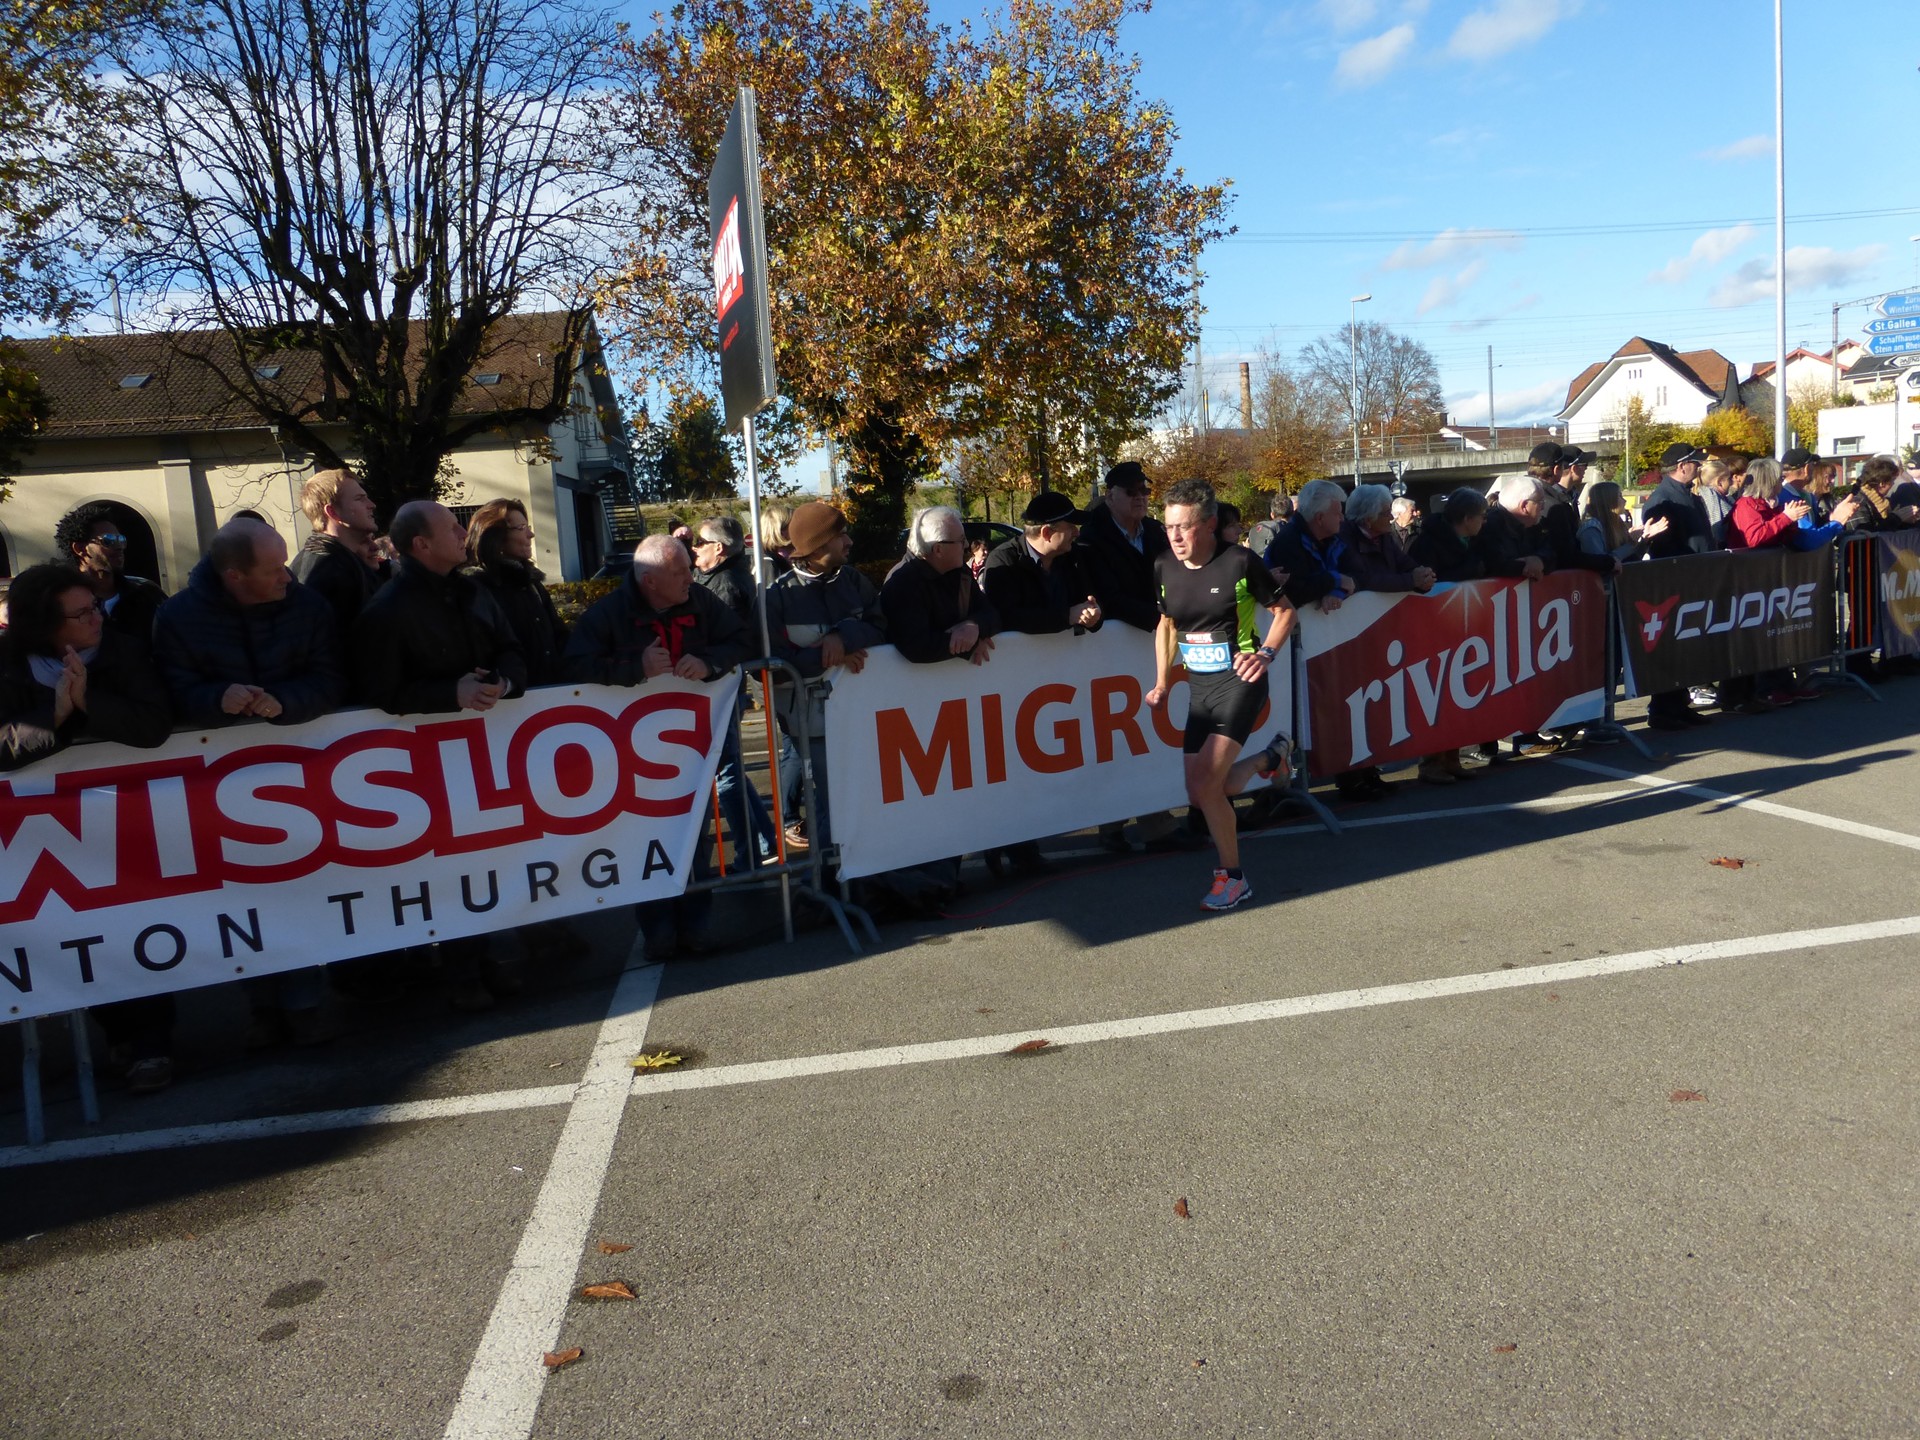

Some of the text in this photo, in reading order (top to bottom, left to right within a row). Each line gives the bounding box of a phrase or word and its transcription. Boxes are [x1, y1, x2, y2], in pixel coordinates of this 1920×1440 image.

[1674, 582, 1817, 640] CUORE
[1188, 646, 1226, 664] 6350
[1345, 579, 1574, 767] rivella
[328, 839, 676, 936] THURGA
